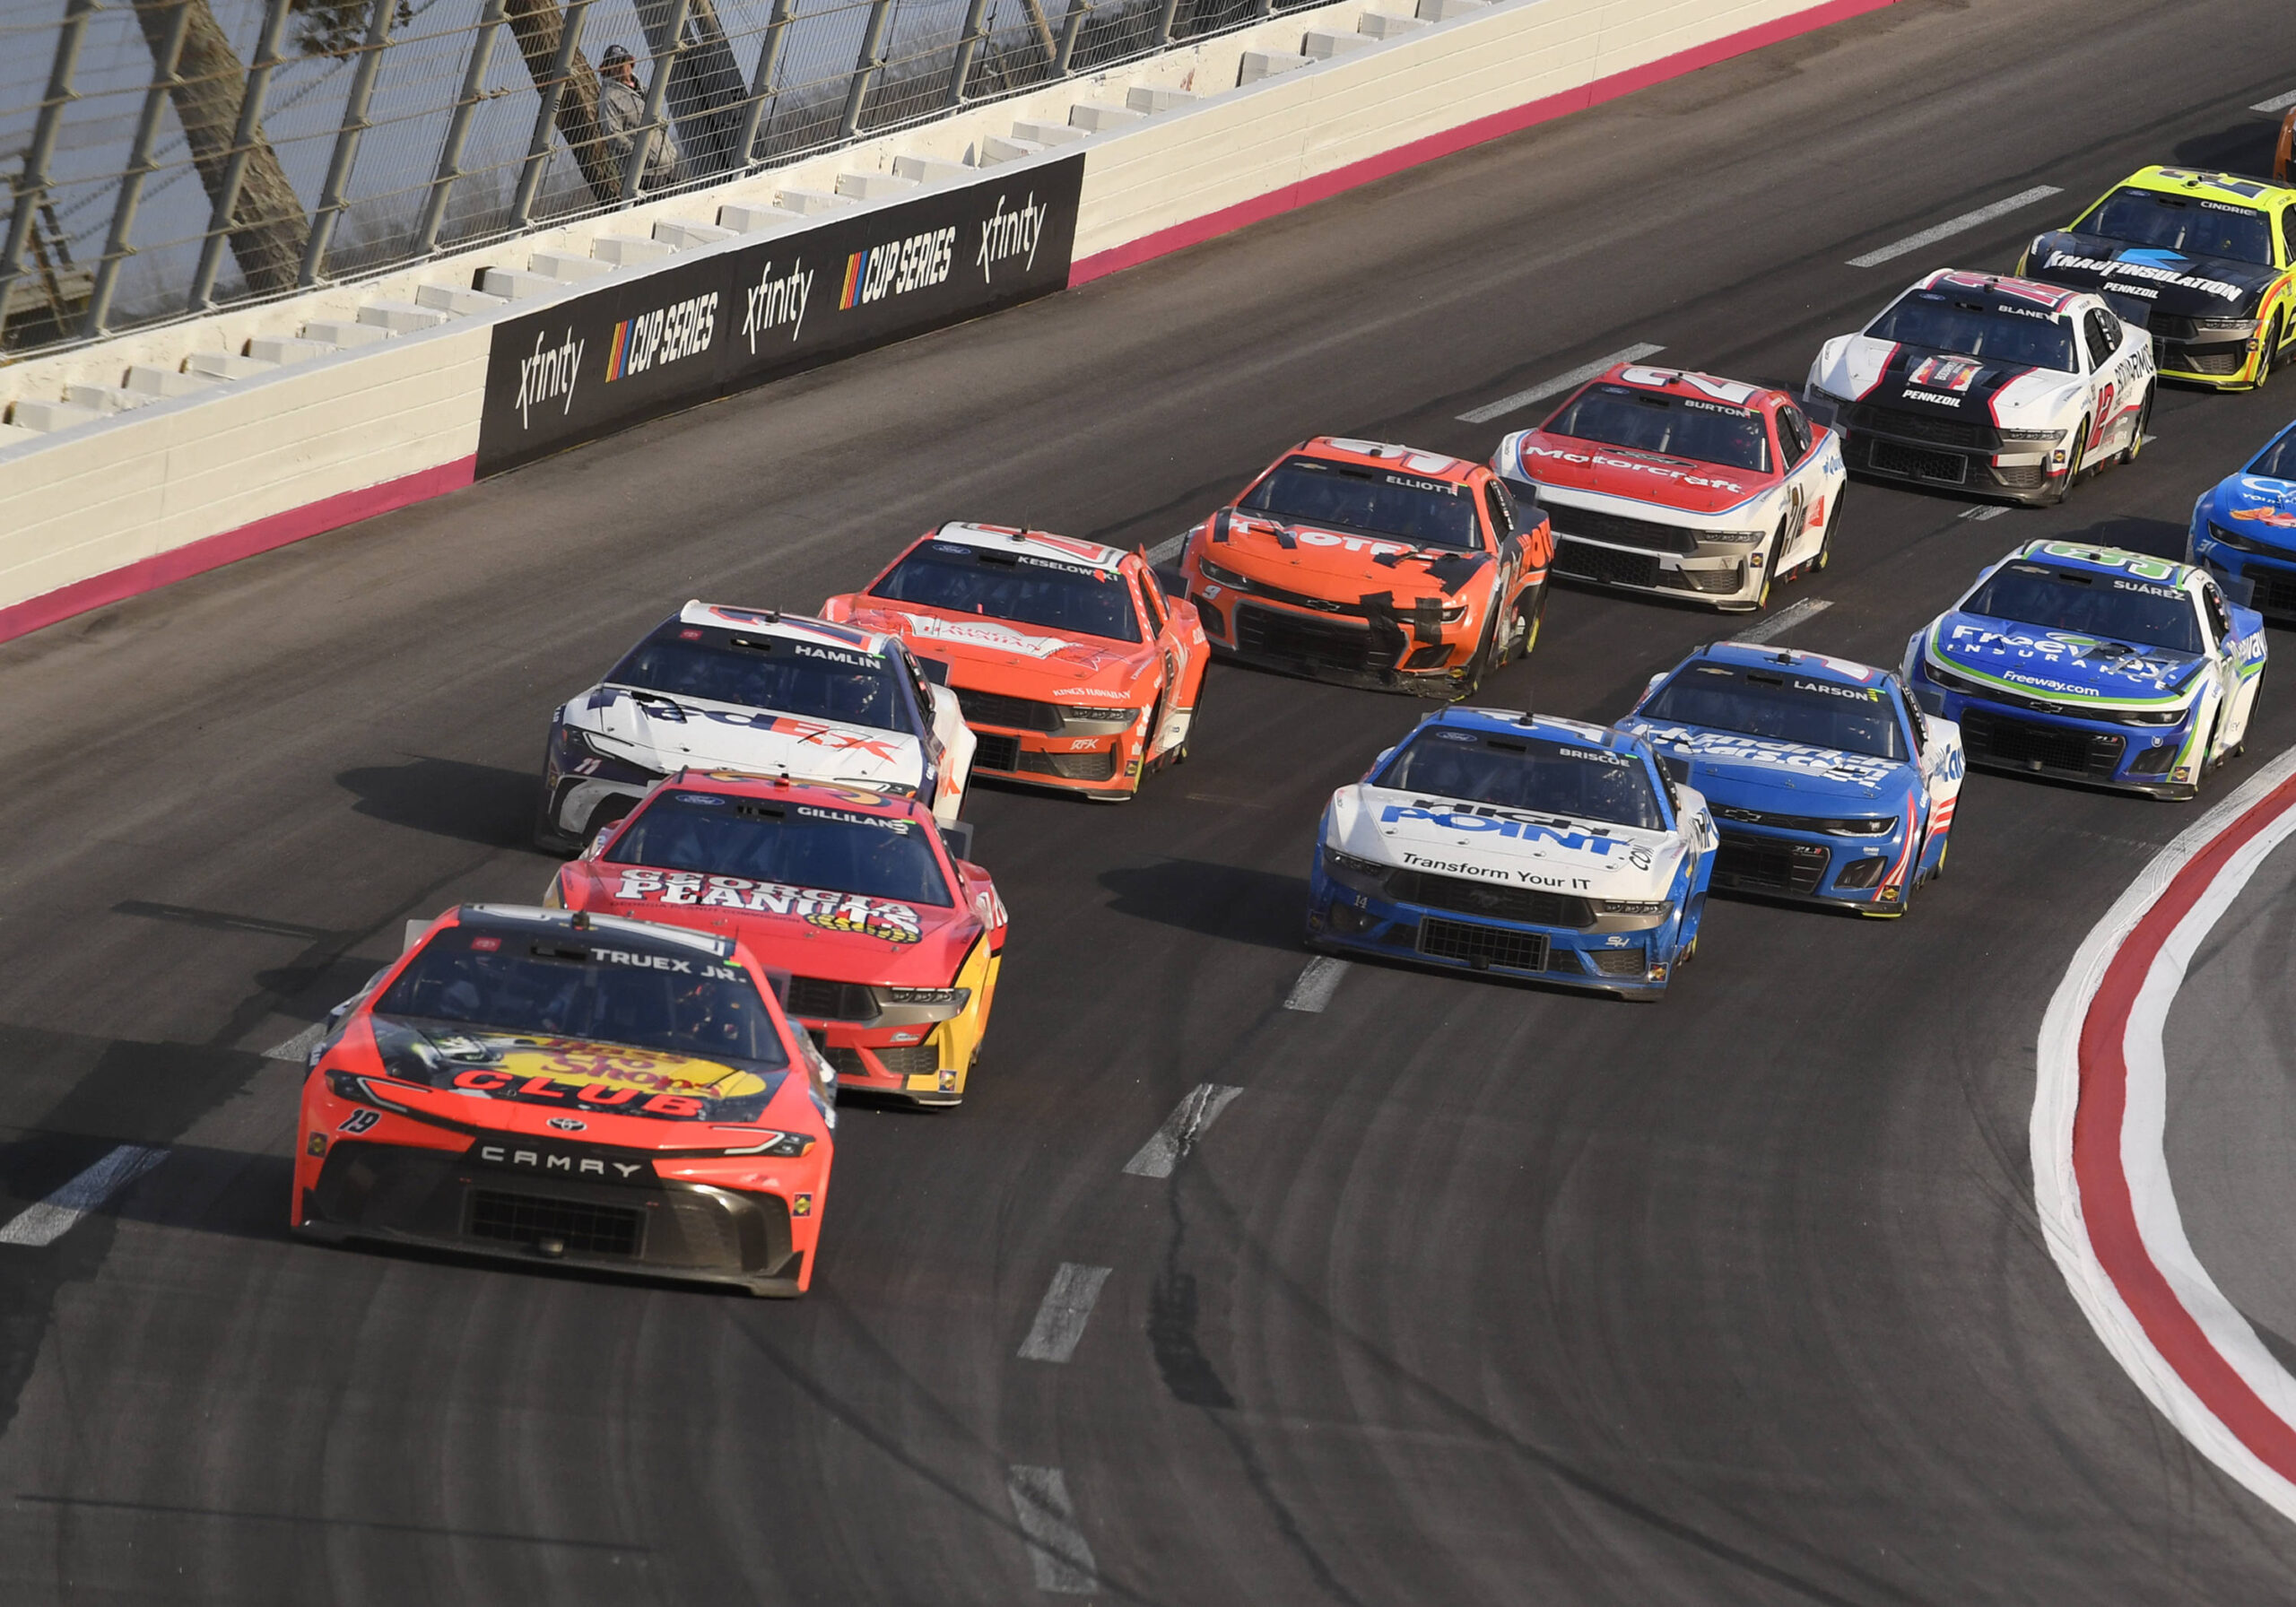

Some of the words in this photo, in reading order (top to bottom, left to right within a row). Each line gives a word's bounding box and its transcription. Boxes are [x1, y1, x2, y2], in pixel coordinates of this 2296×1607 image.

[2103, 282, 2159, 299] PENNZOIL
[516, 326, 586, 430] xfinity
[627, 309, 666, 376] CUP
[659, 291, 718, 365] SERIES
[742, 257, 813, 354] xfinity
[862, 240, 902, 304] CUP
[896, 226, 956, 295] SERIES
[977, 191, 1047, 283] xfinity
[1684, 400, 1748, 418] BURTON
[1902, 389, 1961, 407] PENNZOIL
[1526, 447, 1744, 494] Motorcraft
[2196, 539, 2218, 552] 31
[1018, 556, 1118, 581] KESELOWKI
[1203, 586, 1222, 599] 9
[2113, 579, 2186, 601] SUÁREZ
[796, 646, 881, 669] HAMLIN
[1794, 682, 1868, 701] LARSON
[2003, 671, 2099, 697] Freeway.com
[574, 757, 602, 775] 11
[1560, 748, 1630, 767] BRISCOE
[1403, 852, 1509, 880] Transform
[1518, 870, 1565, 889] Your
[1572, 878, 1591, 890] IT
[615, 879, 922, 934] PEANUTS
[621, 869, 918, 923] GEORGIA
[1354, 896, 1368, 908] 14
[591, 948, 691, 974] TRUEX
[700, 964, 747, 983] JR.
[453, 1070, 704, 1117] CLUB
[337, 1108, 380, 1135] 19
[481, 1146, 641, 1177] CAMRY
